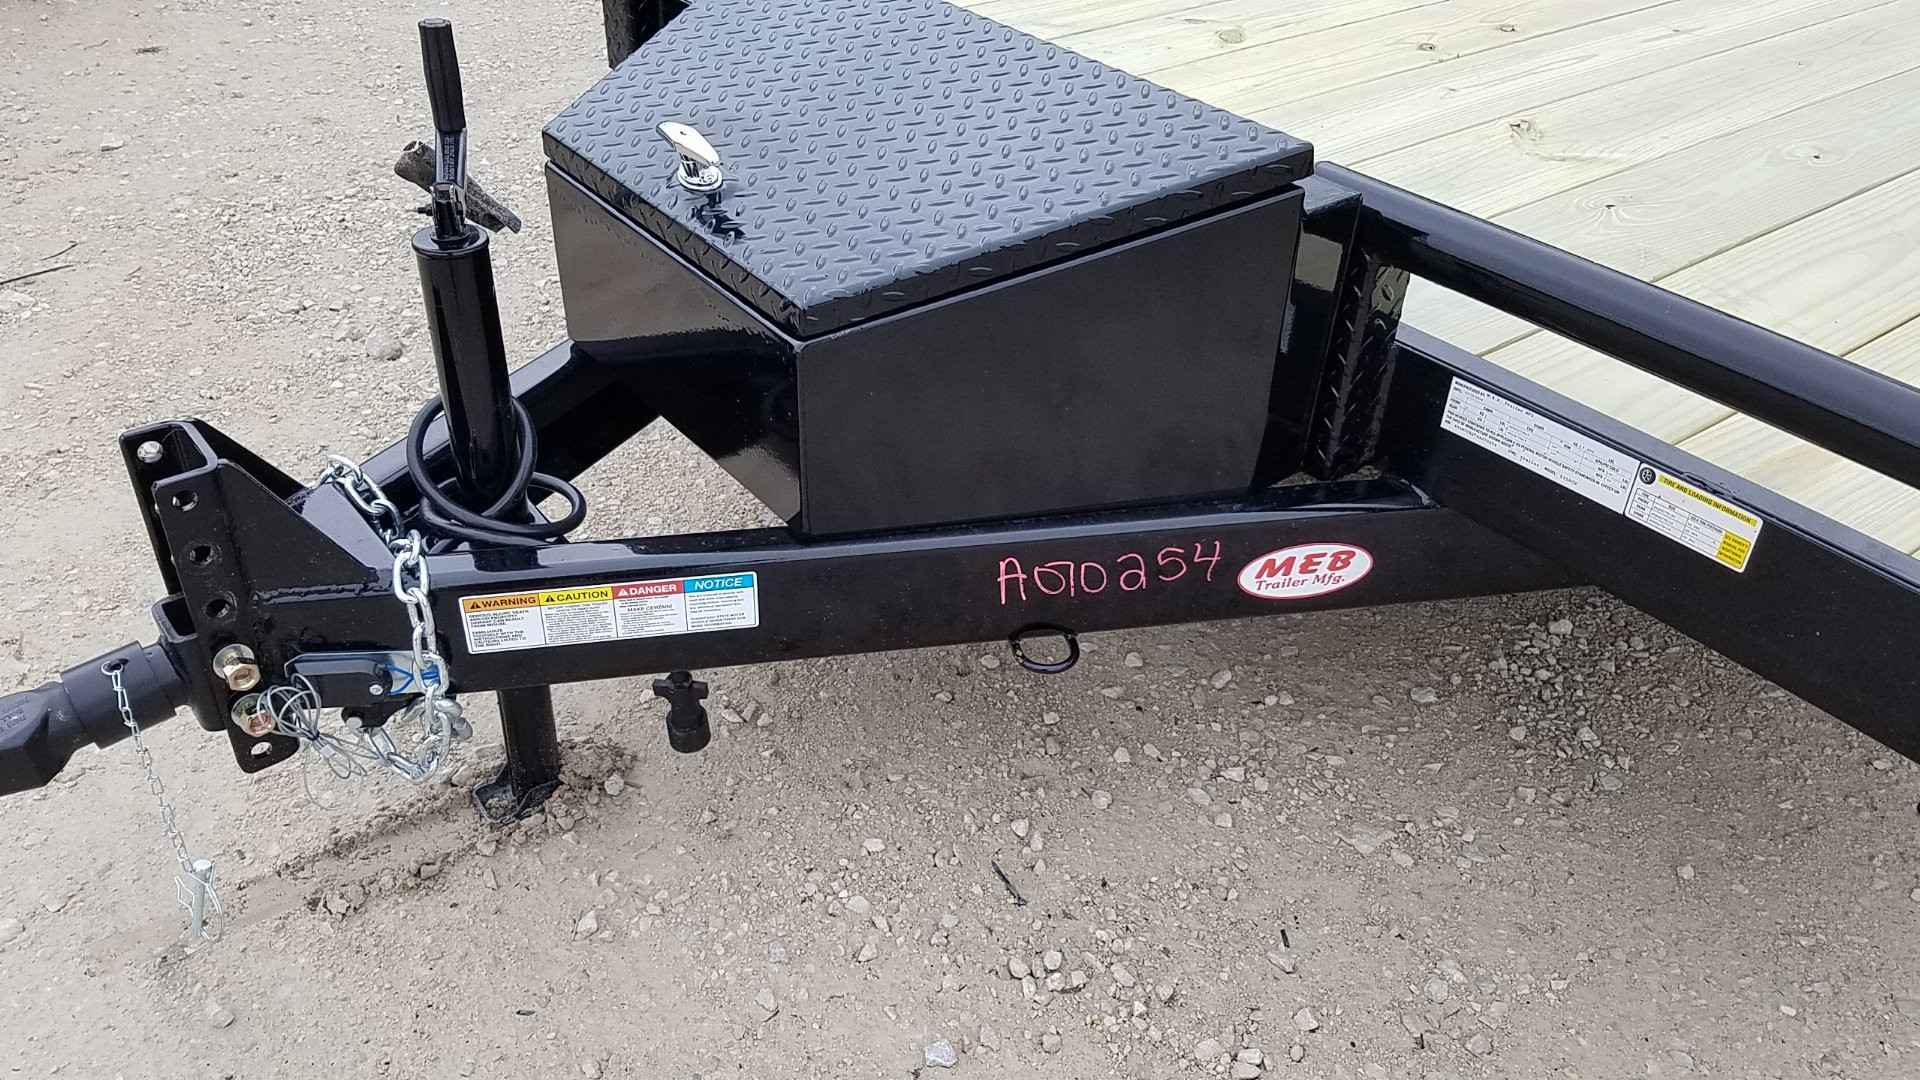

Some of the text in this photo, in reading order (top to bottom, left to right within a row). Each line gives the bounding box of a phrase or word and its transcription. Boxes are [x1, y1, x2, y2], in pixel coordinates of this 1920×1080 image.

[1663, 477, 1751, 524] TIRE AND LOADING INFORMATION
[1254, 550, 1356, 580] MEB
[694, 577, 744, 590] NOTICE
[1254, 572, 1346, 593] Trailer Mfg.
[556, 590, 609, 602] CAUTION
[629, 583, 678, 596] DANGER
[481, 596, 537, 608] WARNING
